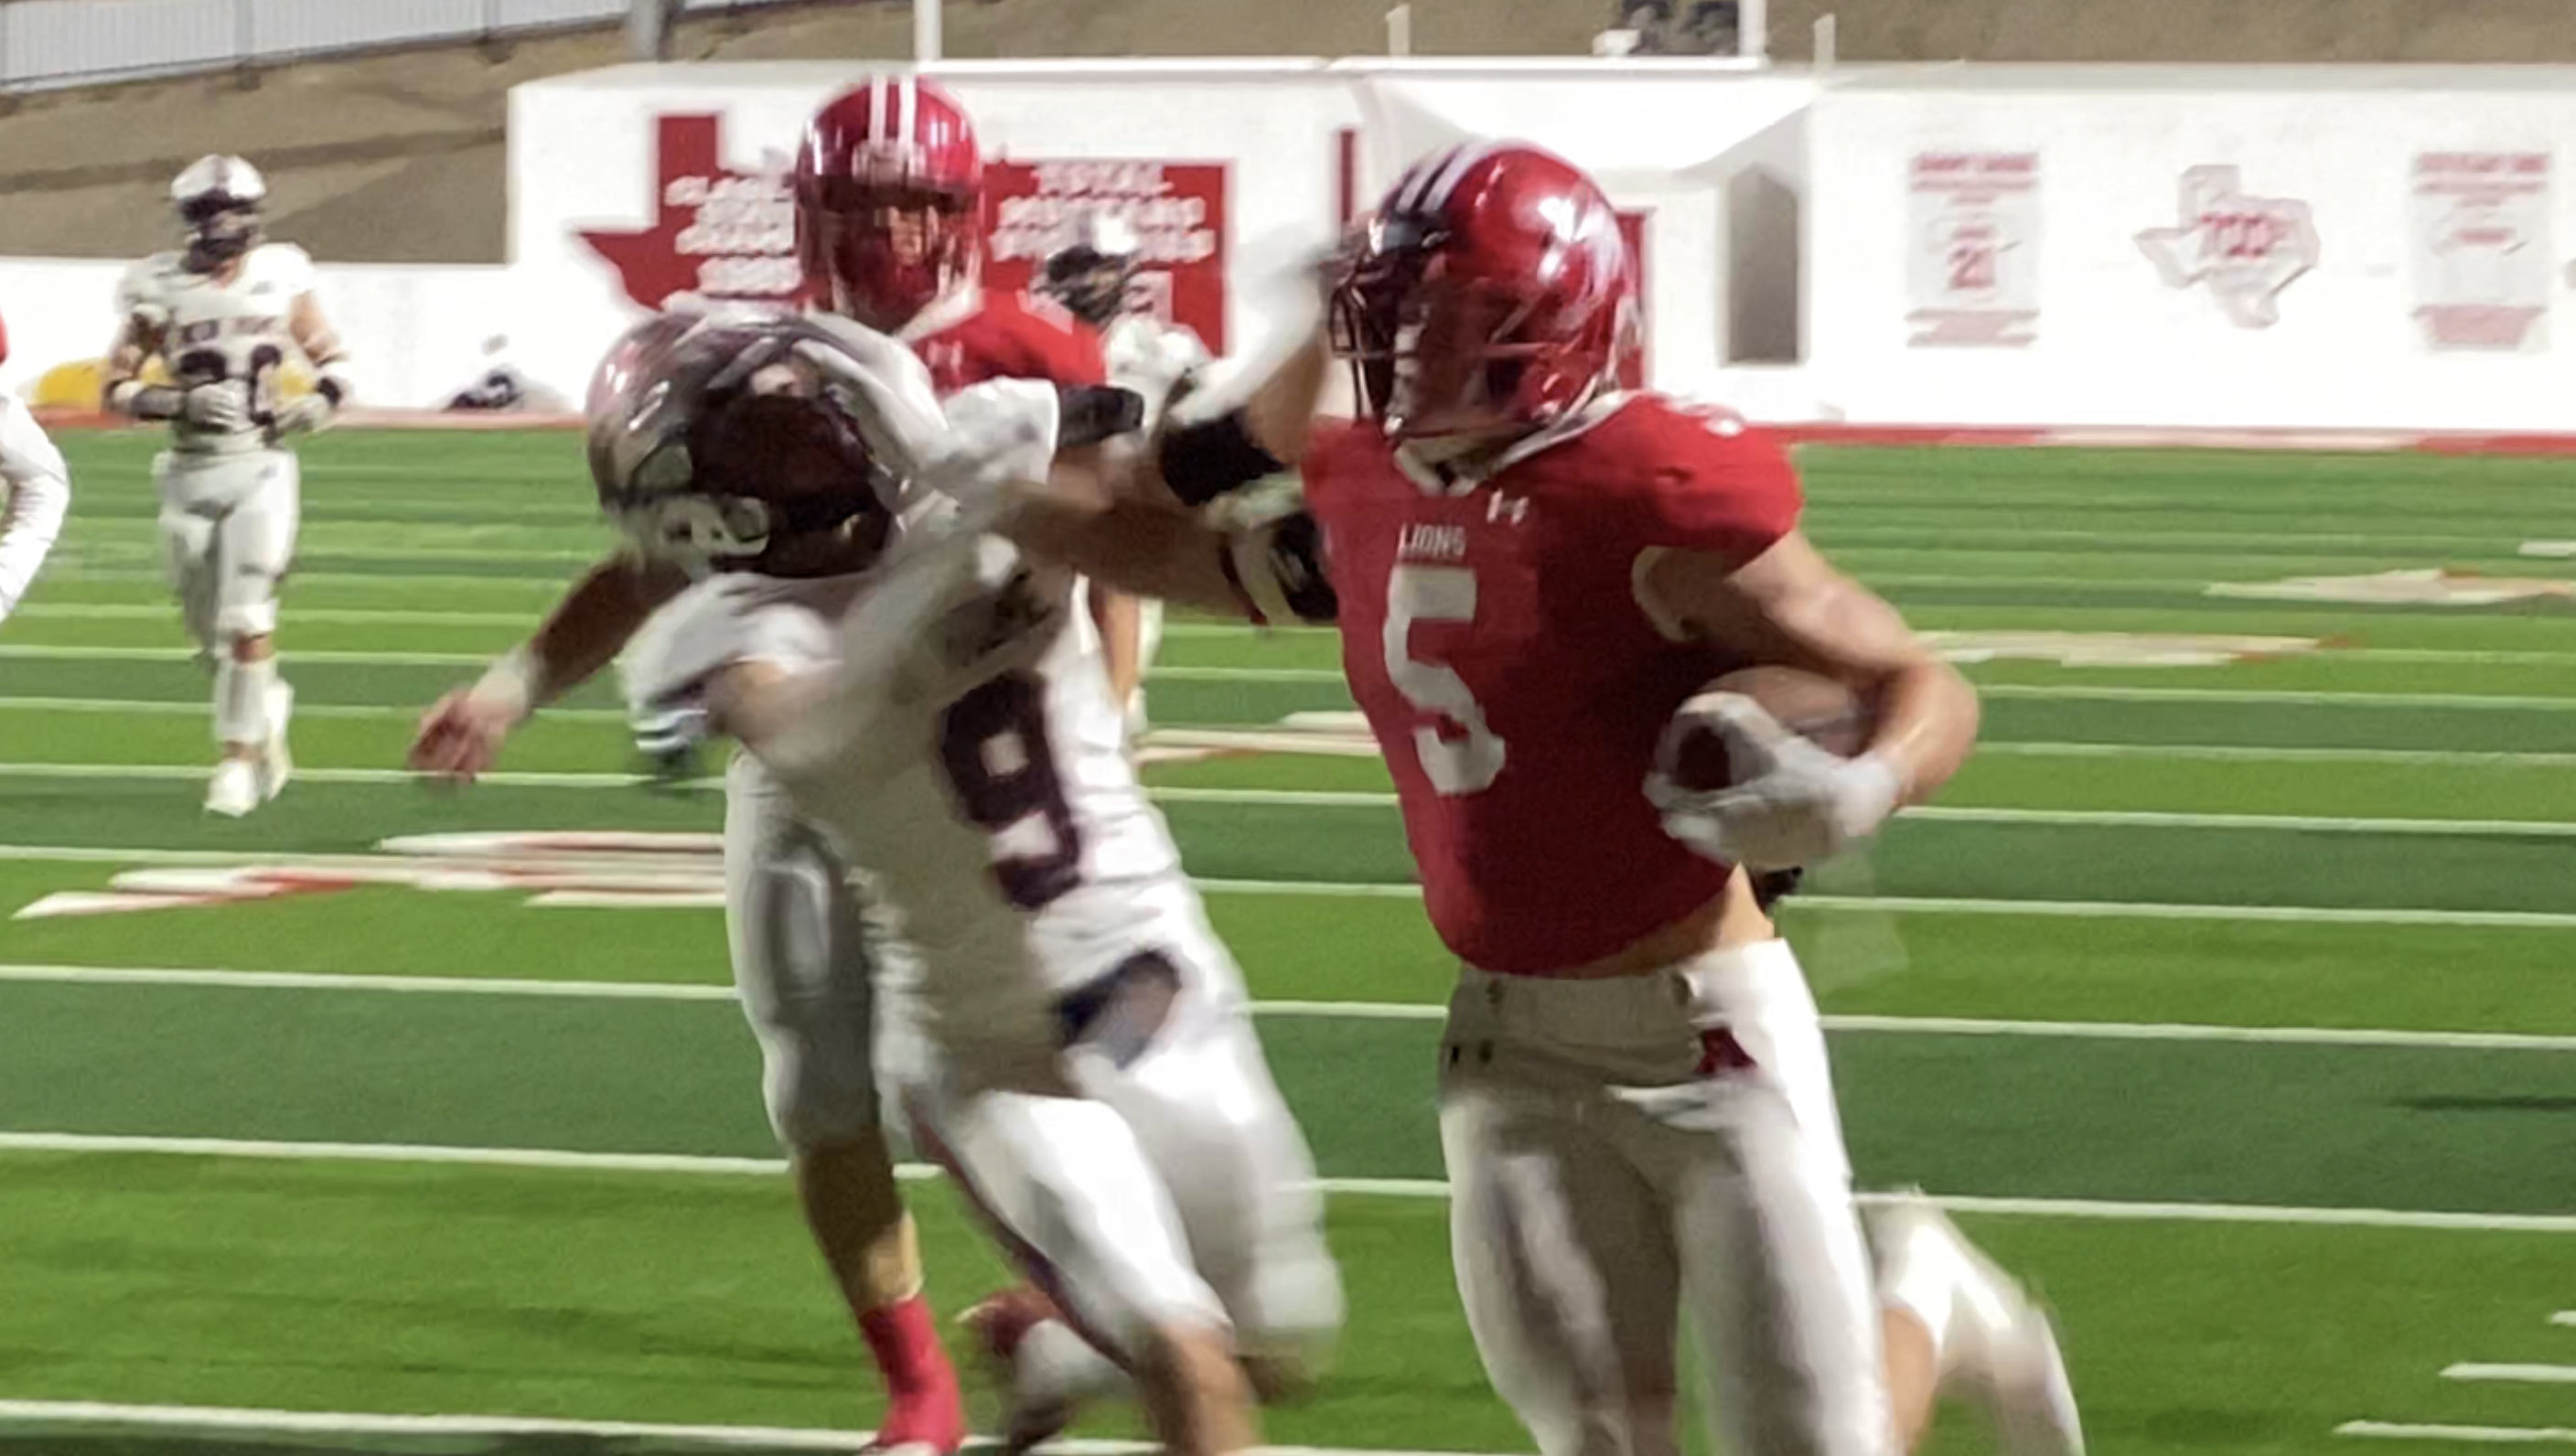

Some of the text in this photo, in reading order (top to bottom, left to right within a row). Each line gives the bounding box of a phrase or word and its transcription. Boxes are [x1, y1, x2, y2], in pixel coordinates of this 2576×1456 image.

[1398, 522, 1466, 561] LIONS
[940, 669, 1082, 907] 9
[1383, 564, 1505, 795] 5
